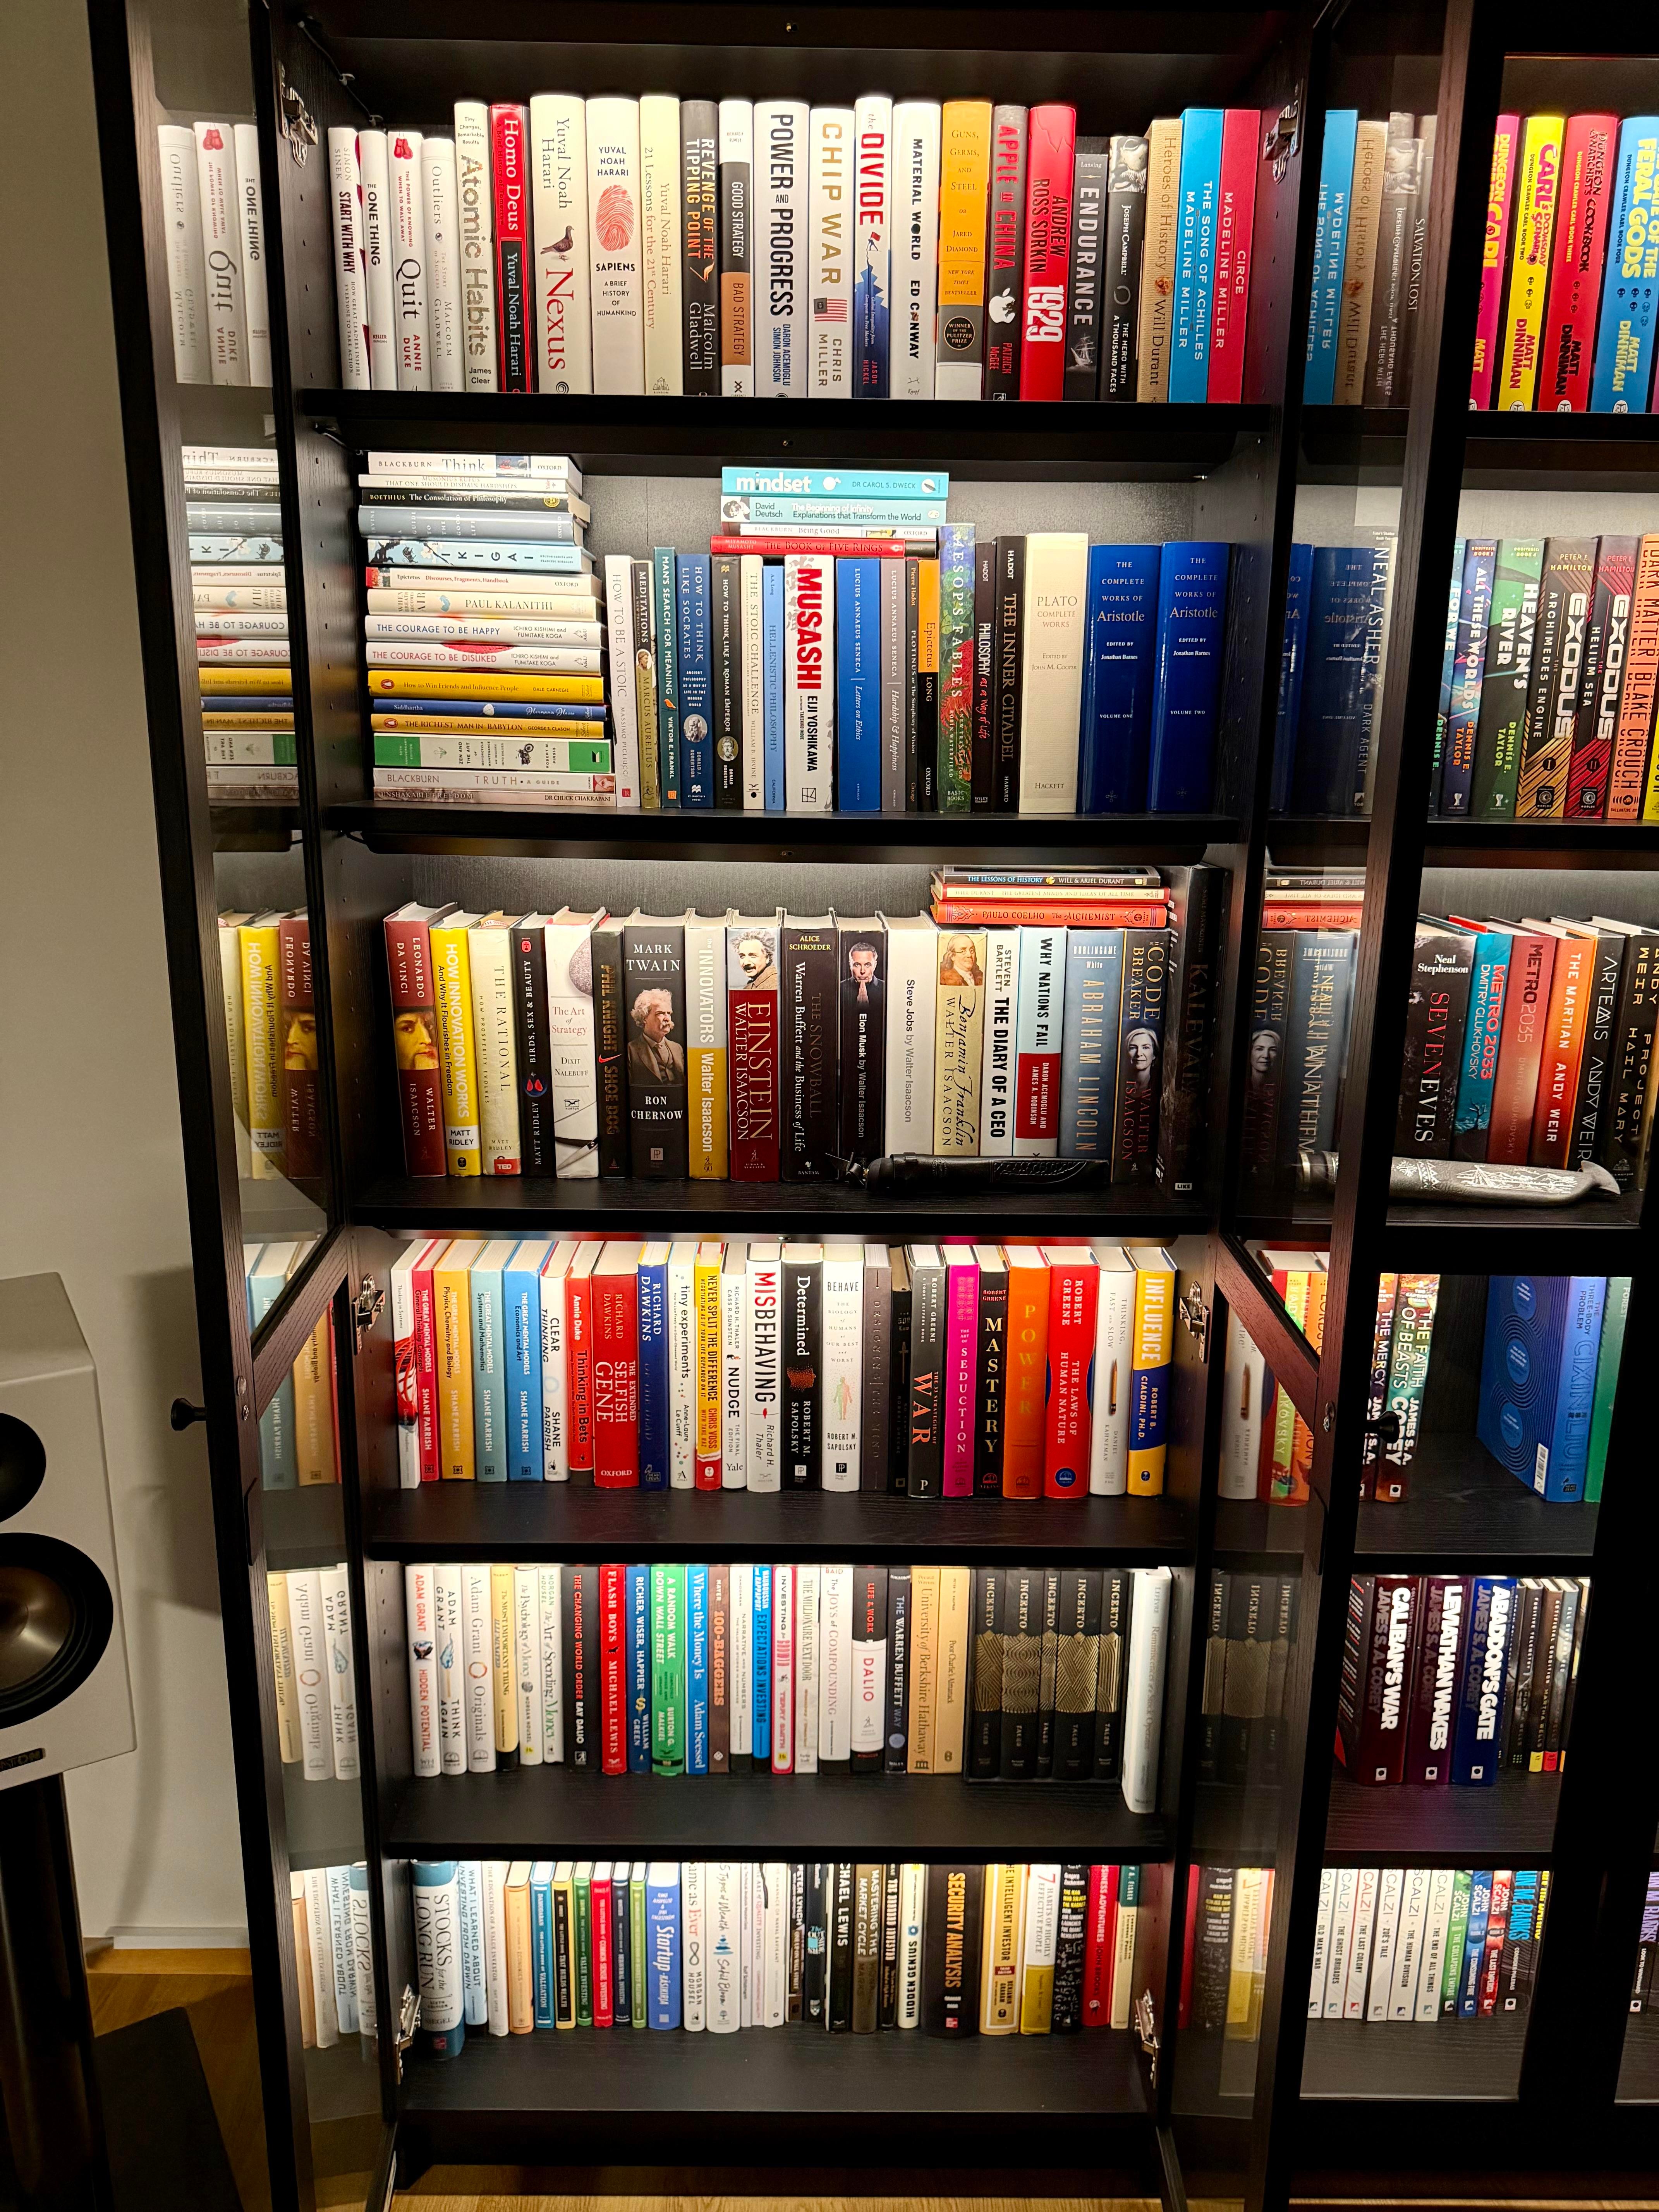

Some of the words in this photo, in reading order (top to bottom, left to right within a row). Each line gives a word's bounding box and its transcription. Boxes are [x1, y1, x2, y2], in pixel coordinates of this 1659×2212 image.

[771, 114, 793, 189] POWER
[822, 123, 842, 201] CHIP
[776, 194, 788, 203] AND
[860, 133, 884, 225] DIVIDE
[340, 192, 352, 225] START
[368, 192, 377, 221] ONE
[460, 155, 486, 258] Atomic
[341, 227, 354, 252] WITH
[369, 223, 380, 266] THING
[821, 214, 842, 284] WAR
[1073, 188, 1099, 326] ENDURANCE
[343, 255, 356, 273] WHY
[771, 209, 793, 316] PROGRESS
[396, 258, 421, 319] Quit
[466, 269, 490, 356] Habits
[546, 268, 574, 369] Nexus
[1026, 285, 1066, 342] 1929
[1509, 319, 1527, 389] DINNIMAN
[1526, 335, 1535, 370] MATT
[442, 459, 486, 472] Think
[736, 473, 811, 493] mindset
[472, 495, 507, 504] Philosophy
[838, 512, 850, 520] that
[638, 572, 648, 643] MEDITATIONS
[1037, 596, 1077, 606] PLATO
[1097, 611, 1144, 622] Aristotle
[377, 623, 393, 632] THE
[396, 624, 440, 634] COURAGE
[472, 627, 500, 635] HAPPY
[797, 568, 822, 690] MUSASHI
[1497, 608, 1517, 665] RIVER
[1513, 584, 1539, 689] HEAVEN'S
[808, 696, 818, 712] EIJI
[807, 714, 818, 771] YOSHIKAWA
[397, 943, 404, 957] DA
[413, 938, 424, 998] LEONARDO
[446, 944, 458, 977] HOW
[626, 959, 680, 971] TWAIN
[634, 944, 672, 953] MARK
[1039, 938, 1053, 966] WHY
[1418, 965, 1468, 975] Stephenson
[1434, 955, 1456, 963] Neal
[1567, 953, 1581, 979] THE
[398, 961, 408, 993] VINCI
[699, 950, 714, 1043] INNOVATORS
[1037, 972, 1051, 1018] NATIONS
[449, 980, 465, 1066] INNOVATION
[1036, 1024, 1048, 1047] FAIL
[1079, 980, 1104, 1063] ABRAHAM
[1559, 986, 1576, 1048] MARTIAN
[701, 1053, 714, 1094] Walter
[748, 1002, 772, 1140] EINSTEIN
[1414, 993, 1450, 1141] SEVENEVES
[1552, 1063, 1566, 1100] ANDY
[455, 1069, 469, 1118] WORKS
[631, 1110, 683, 1120] CHERNOW
[645, 1096, 667, 1104] RON
[1075, 1077, 1100, 1151] LINCOLN
[701, 1097, 713, 1152] Isaacson
[1546, 1109, 1560, 1142] WEIR
[828, 1281, 859, 1291] BEHAVE
[797, 1276, 810, 1357] Determined
[1141, 1279, 1165, 1360] INFLUENCE
[1401, 1307, 1417, 1330] OF
[1576, 1291, 1587, 1329] PROBLEM
[550, 1318, 560, 1352] CLEAR
[754, 1272, 776, 1402] MISBEHAVING
[1059, 1352, 1069, 1395] HUMAN
[1393, 1332, 1413, 1389] BEASTS
[596, 1361, 613, 1422] GENE
[614, 1361, 627, 1422] SELFISH
[728, 1367, 740, 1418] NUDGE
[957, 1348, 968, 1453] SEDUCTION
[985, 1318, 1002, 1453] MASTERY
[1057, 1399, 1066, 1444] NATURE
[726, 1463, 743, 1471] Yale
[416, 1575, 424, 1599] ADAM
[608, 1571, 617, 1609] FLASH
[986, 1577, 995, 1626] INCERTO
[416, 1602, 426, 1631] GRANT
[608, 1613, 617, 1642] BOYS
[1435, 1586, 1462, 1688] LEVIATHAN
[714, 1611, 724, 1706] 100-BAGGERS
[863, 1658, 874, 1702] DALIO
[419, 1669, 429, 1701] HIDDEN
[419, 1704, 431, 1751] POTENTIAL
[471, 1686, 487, 1741] Originals
[1430, 1688, 1453, 1750] WAKES
[416, 1896, 431, 1949] LONG
[947, 1872, 965, 1930] SECURITY
[1451, 1890, 1462, 1921] SCALZI
[1460, 1893, 1469, 1917] JOHN
[434, 1894, 452, 1967] STOCKS
[418, 1951, 434, 1990] RUN
[907, 1941, 917, 1978] GENIUS
[945, 1932, 963, 1988] ANALYSIS
[906, 1982, 916, 2018] HIDDEN
